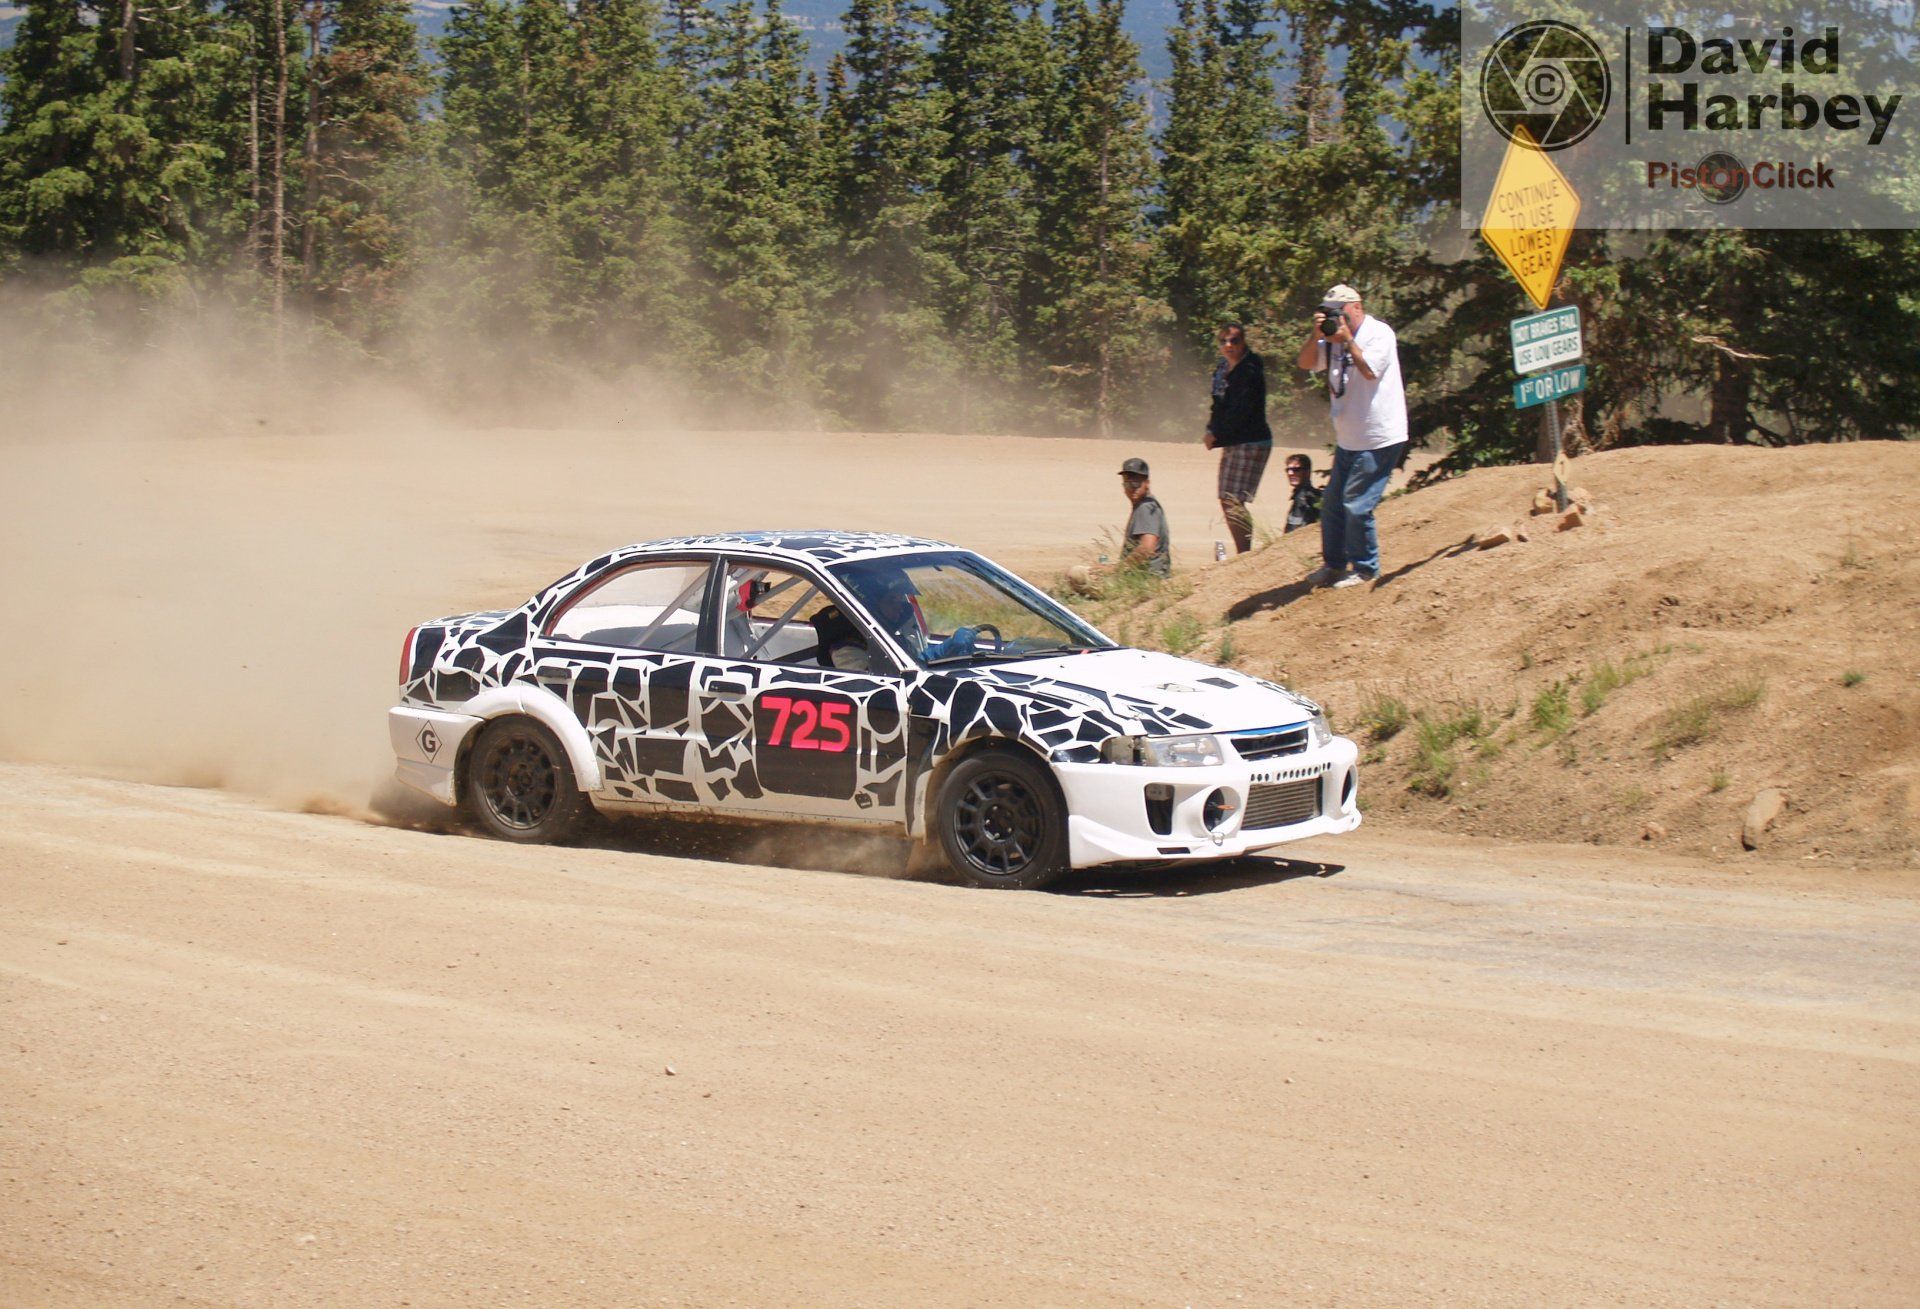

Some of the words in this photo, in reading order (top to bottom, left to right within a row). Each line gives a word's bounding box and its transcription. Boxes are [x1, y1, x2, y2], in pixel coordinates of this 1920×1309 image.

[1499, 179, 1560, 213] CONTINUE
[1510, 212, 1525, 233] TO
[1530, 203, 1555, 228] USE
[1510, 225, 1558, 257] LOWEST
[1521, 250, 1555, 277] GEAR
[1530, 317, 1559, 339] BRAKES
[1519, 349, 1533, 366] USE
[1552, 336, 1579, 357] GEARS
[1535, 377, 1554, 400] OR
[1554, 369, 1581, 394] LOW
[761, 696, 851, 753] 725
[421, 729, 437, 754] G
